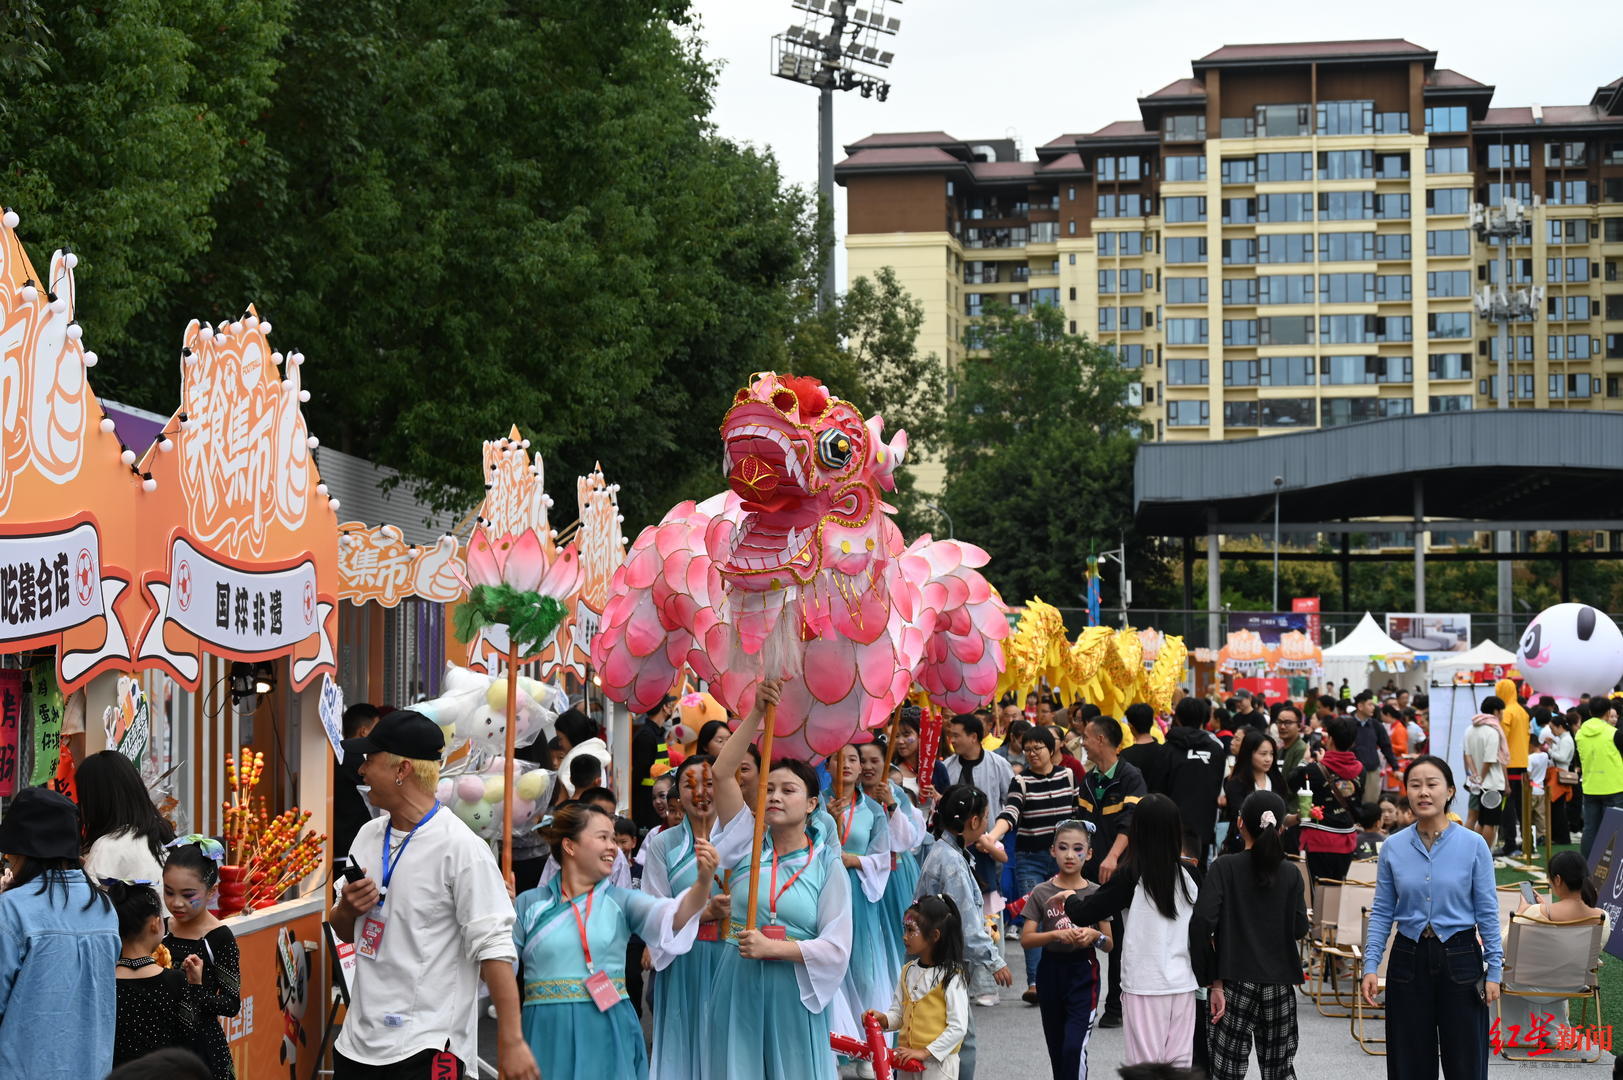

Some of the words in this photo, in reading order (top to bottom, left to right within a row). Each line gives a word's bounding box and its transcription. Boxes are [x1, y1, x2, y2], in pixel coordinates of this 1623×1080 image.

[186, 352, 274, 532] 美食集市
[0, 552, 69, 625] 吃集合店
[215, 581, 282, 637] 国粹非遗
